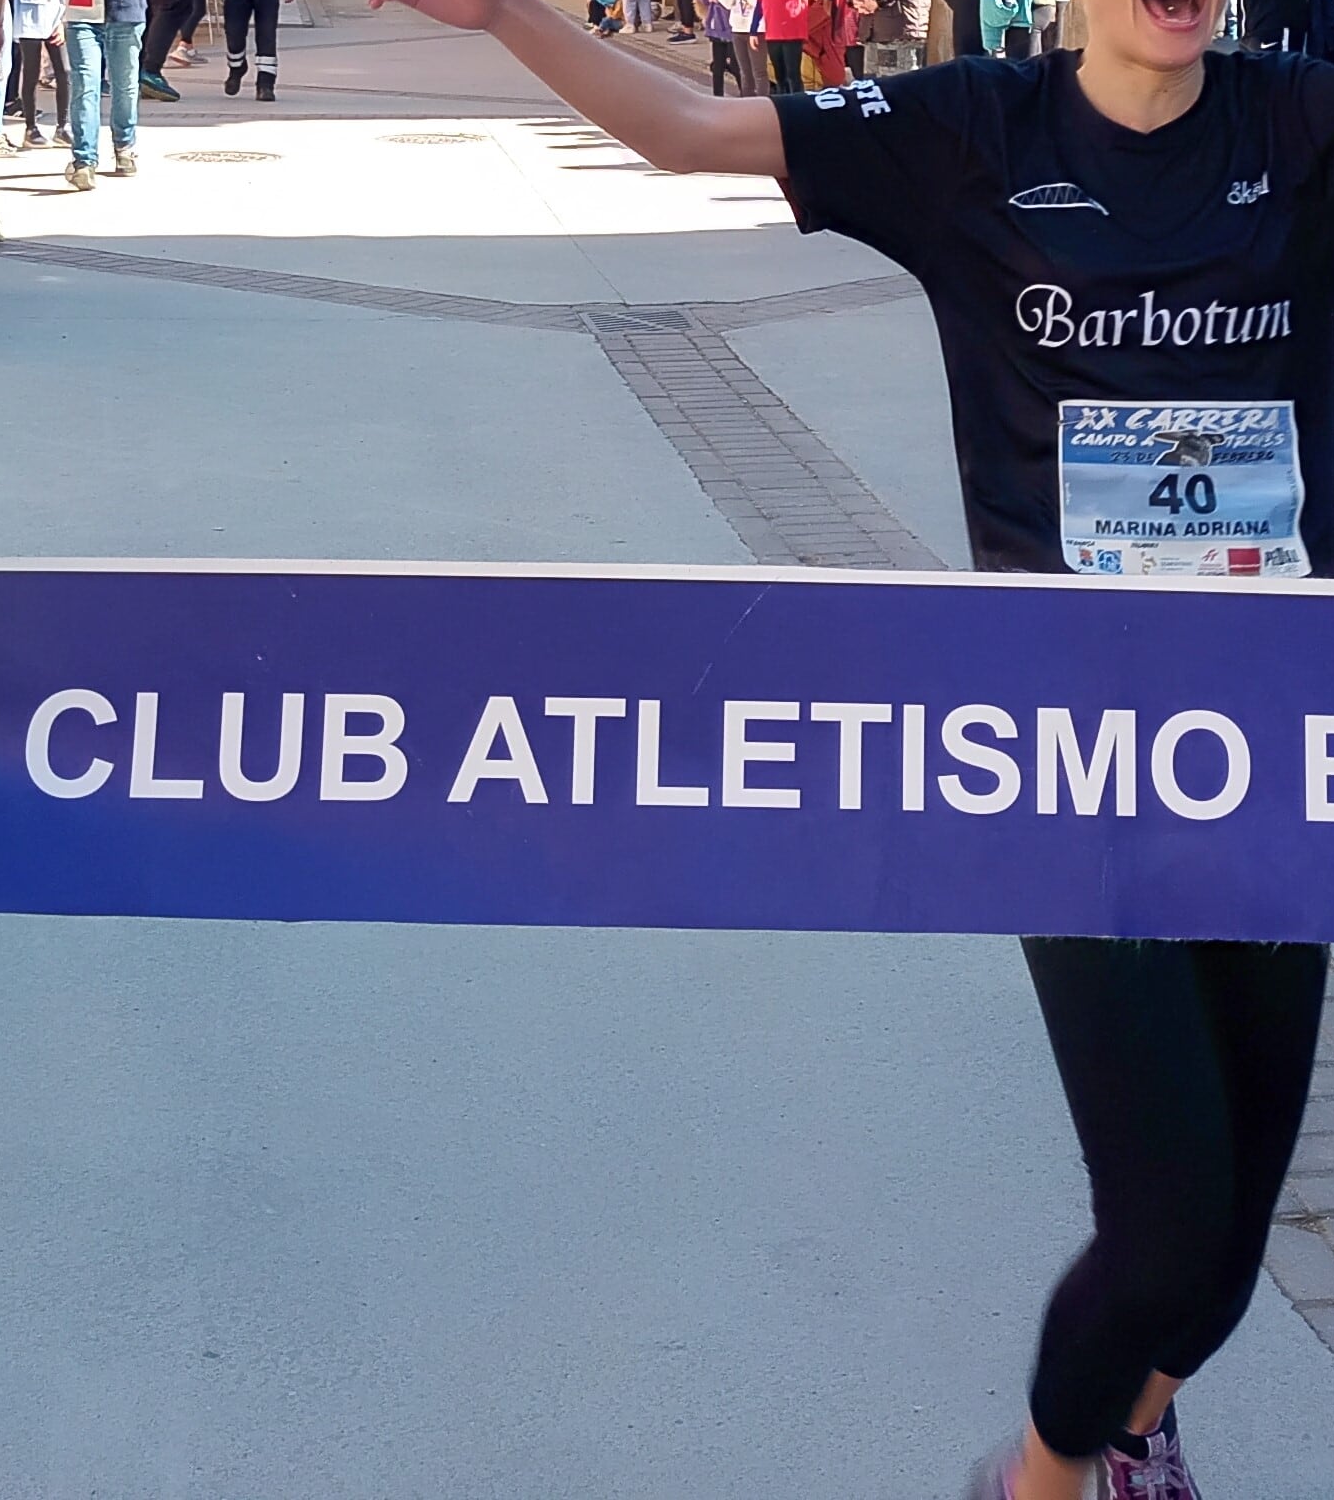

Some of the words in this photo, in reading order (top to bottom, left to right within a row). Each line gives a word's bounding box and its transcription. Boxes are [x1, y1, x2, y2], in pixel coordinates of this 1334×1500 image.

[1016, 283, 1293, 348] Barbotum
[1125, 407, 1280, 434] CARRERA
[1070, 432, 1137, 447] CAMPO
[1148, 473, 1218, 516] 40
[1095, 519, 1176, 536] MARINA
[1182, 519, 1271, 536] ADRIANA
[24, 688, 409, 802] CLUB
[447, 694, 1251, 822] ATLETISMO
